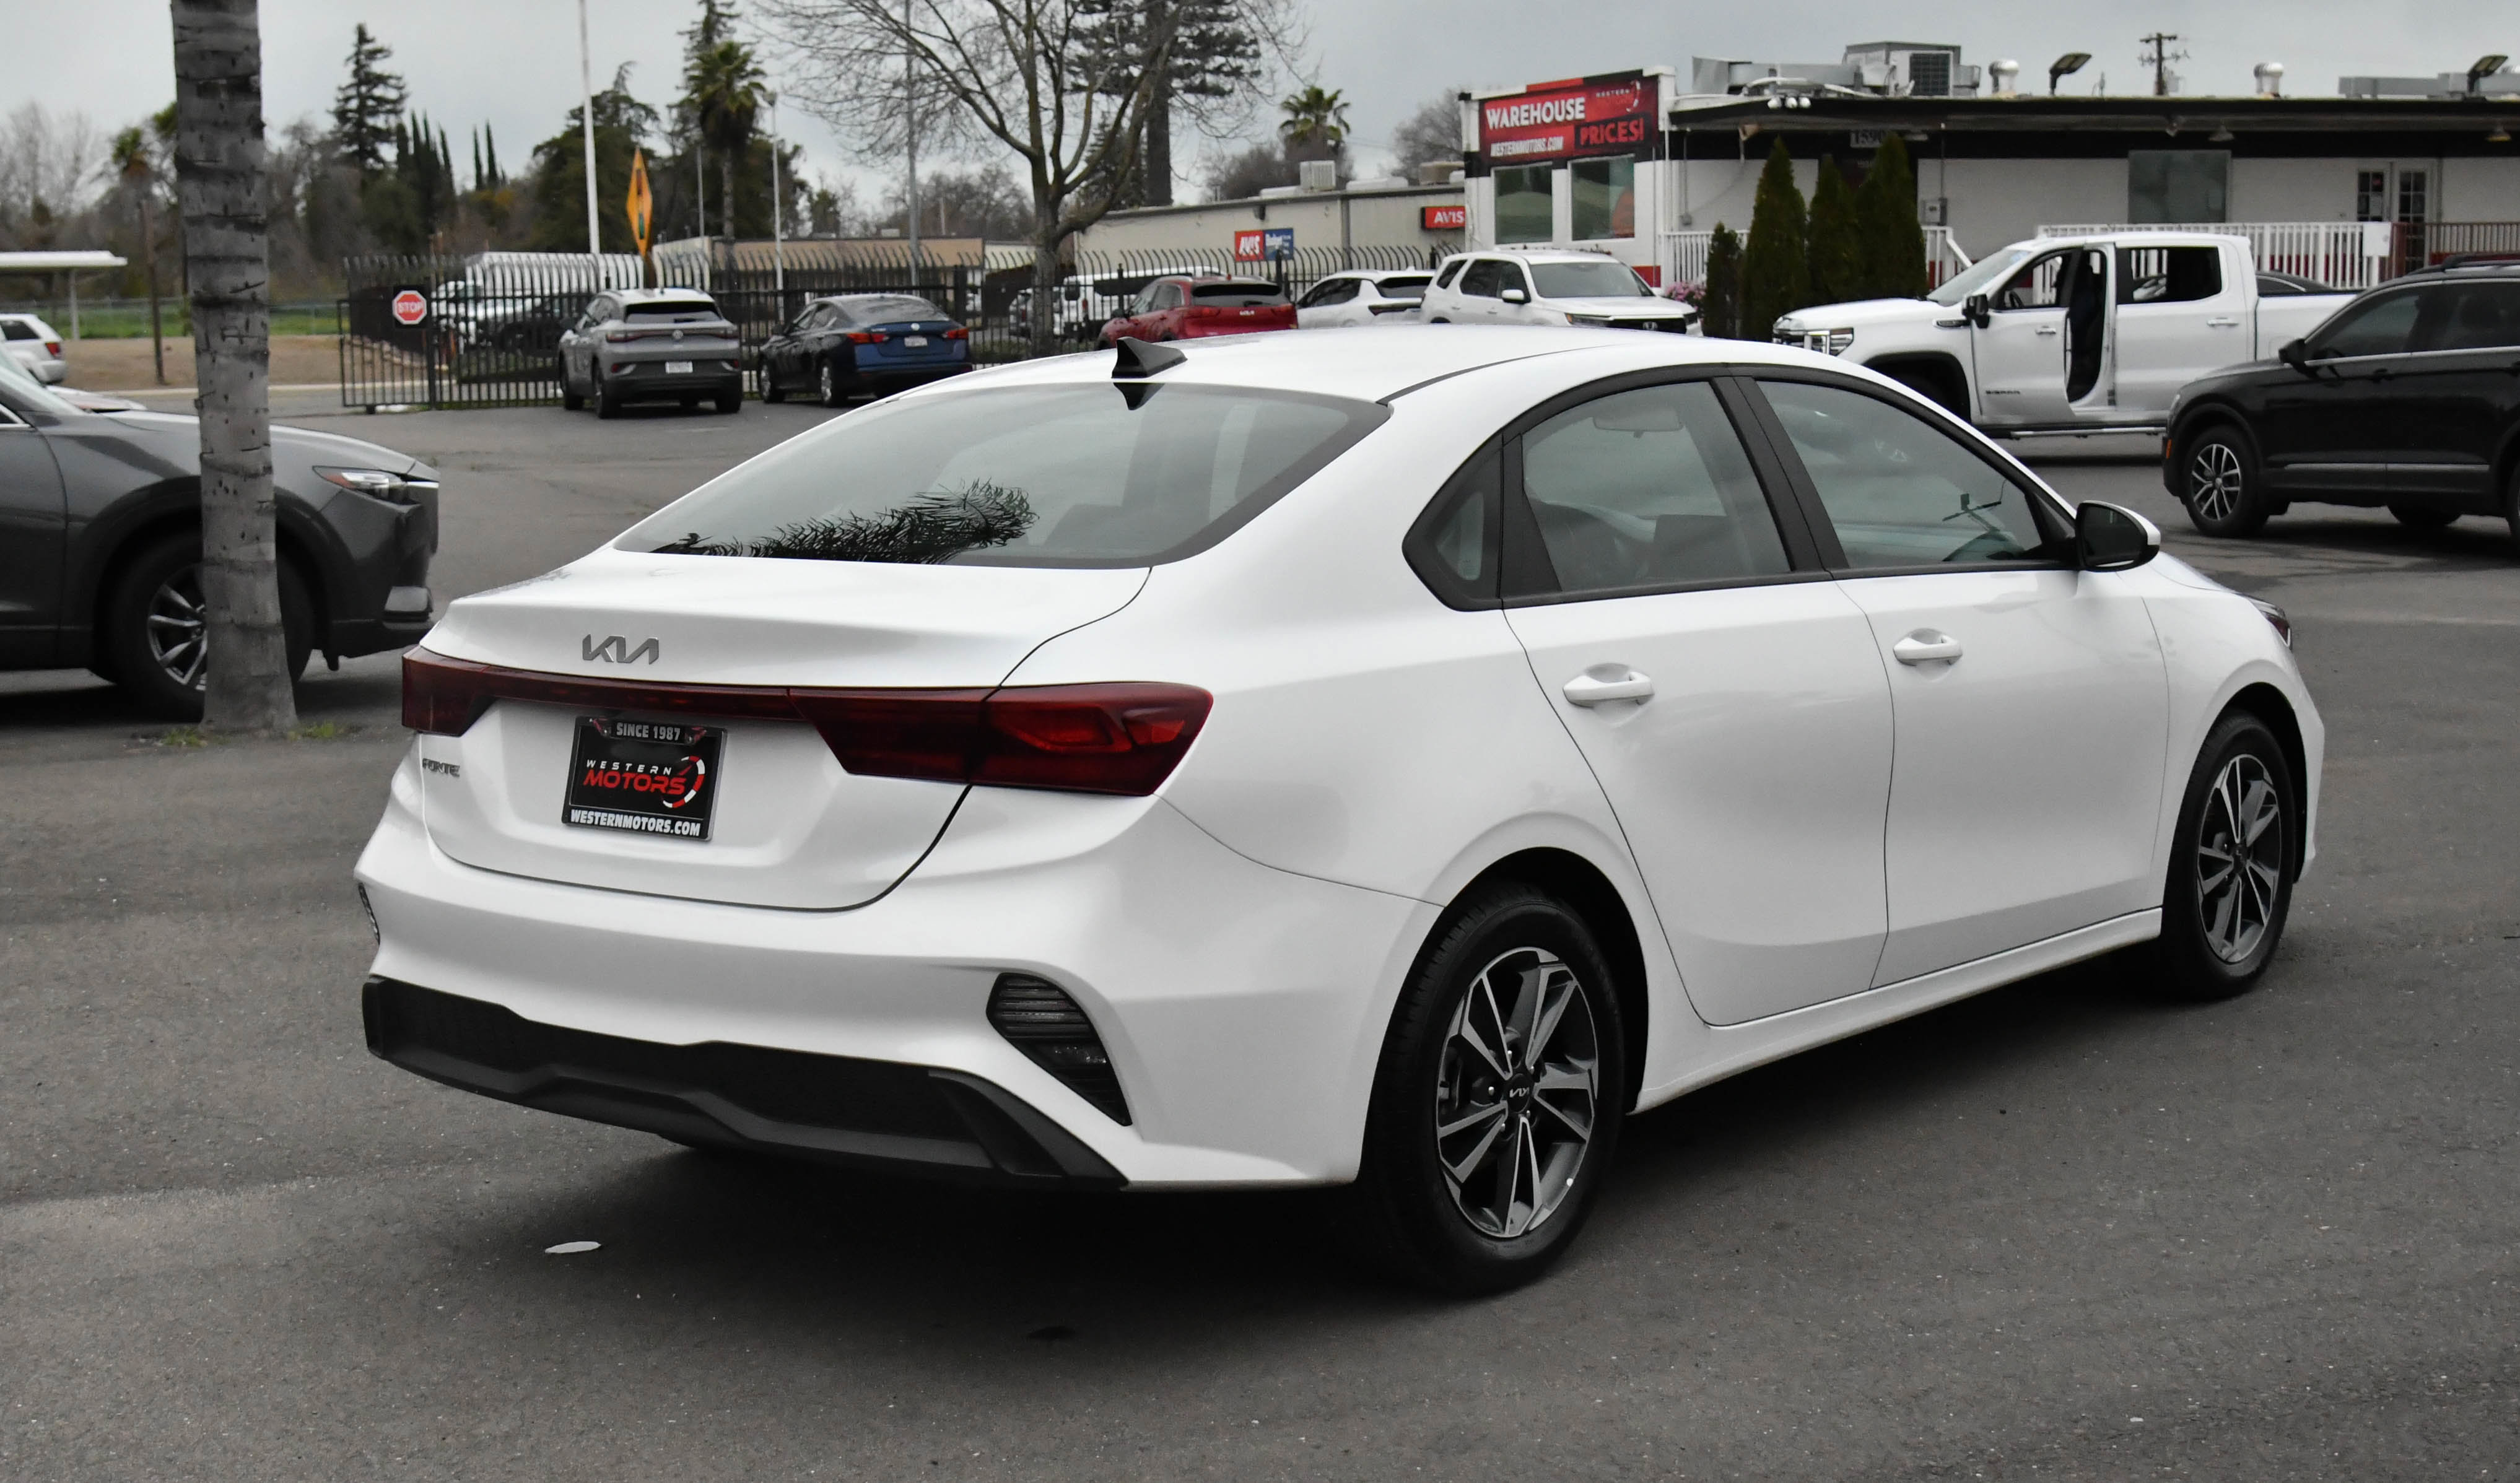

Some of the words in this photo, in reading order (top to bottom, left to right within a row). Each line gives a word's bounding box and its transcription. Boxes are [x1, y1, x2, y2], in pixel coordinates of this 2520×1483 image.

[1486, 97, 1585, 130] WAREHOUSE
[1580, 118, 1644, 146] PRICES!
[1434, 211, 1465, 224] AVIS
[1239, 235, 1260, 255] AVIS
[398, 302, 423, 313] STOP
[582, 634, 660, 664] KIA
[616, 722, 649, 738] SINCE
[653, 726, 681, 741] 1987
[586, 759, 673, 775] WESTERN
[583, 770, 686, 795] MOTORS
[571, 810, 700, 836] WESTERNMOTORS.COM
